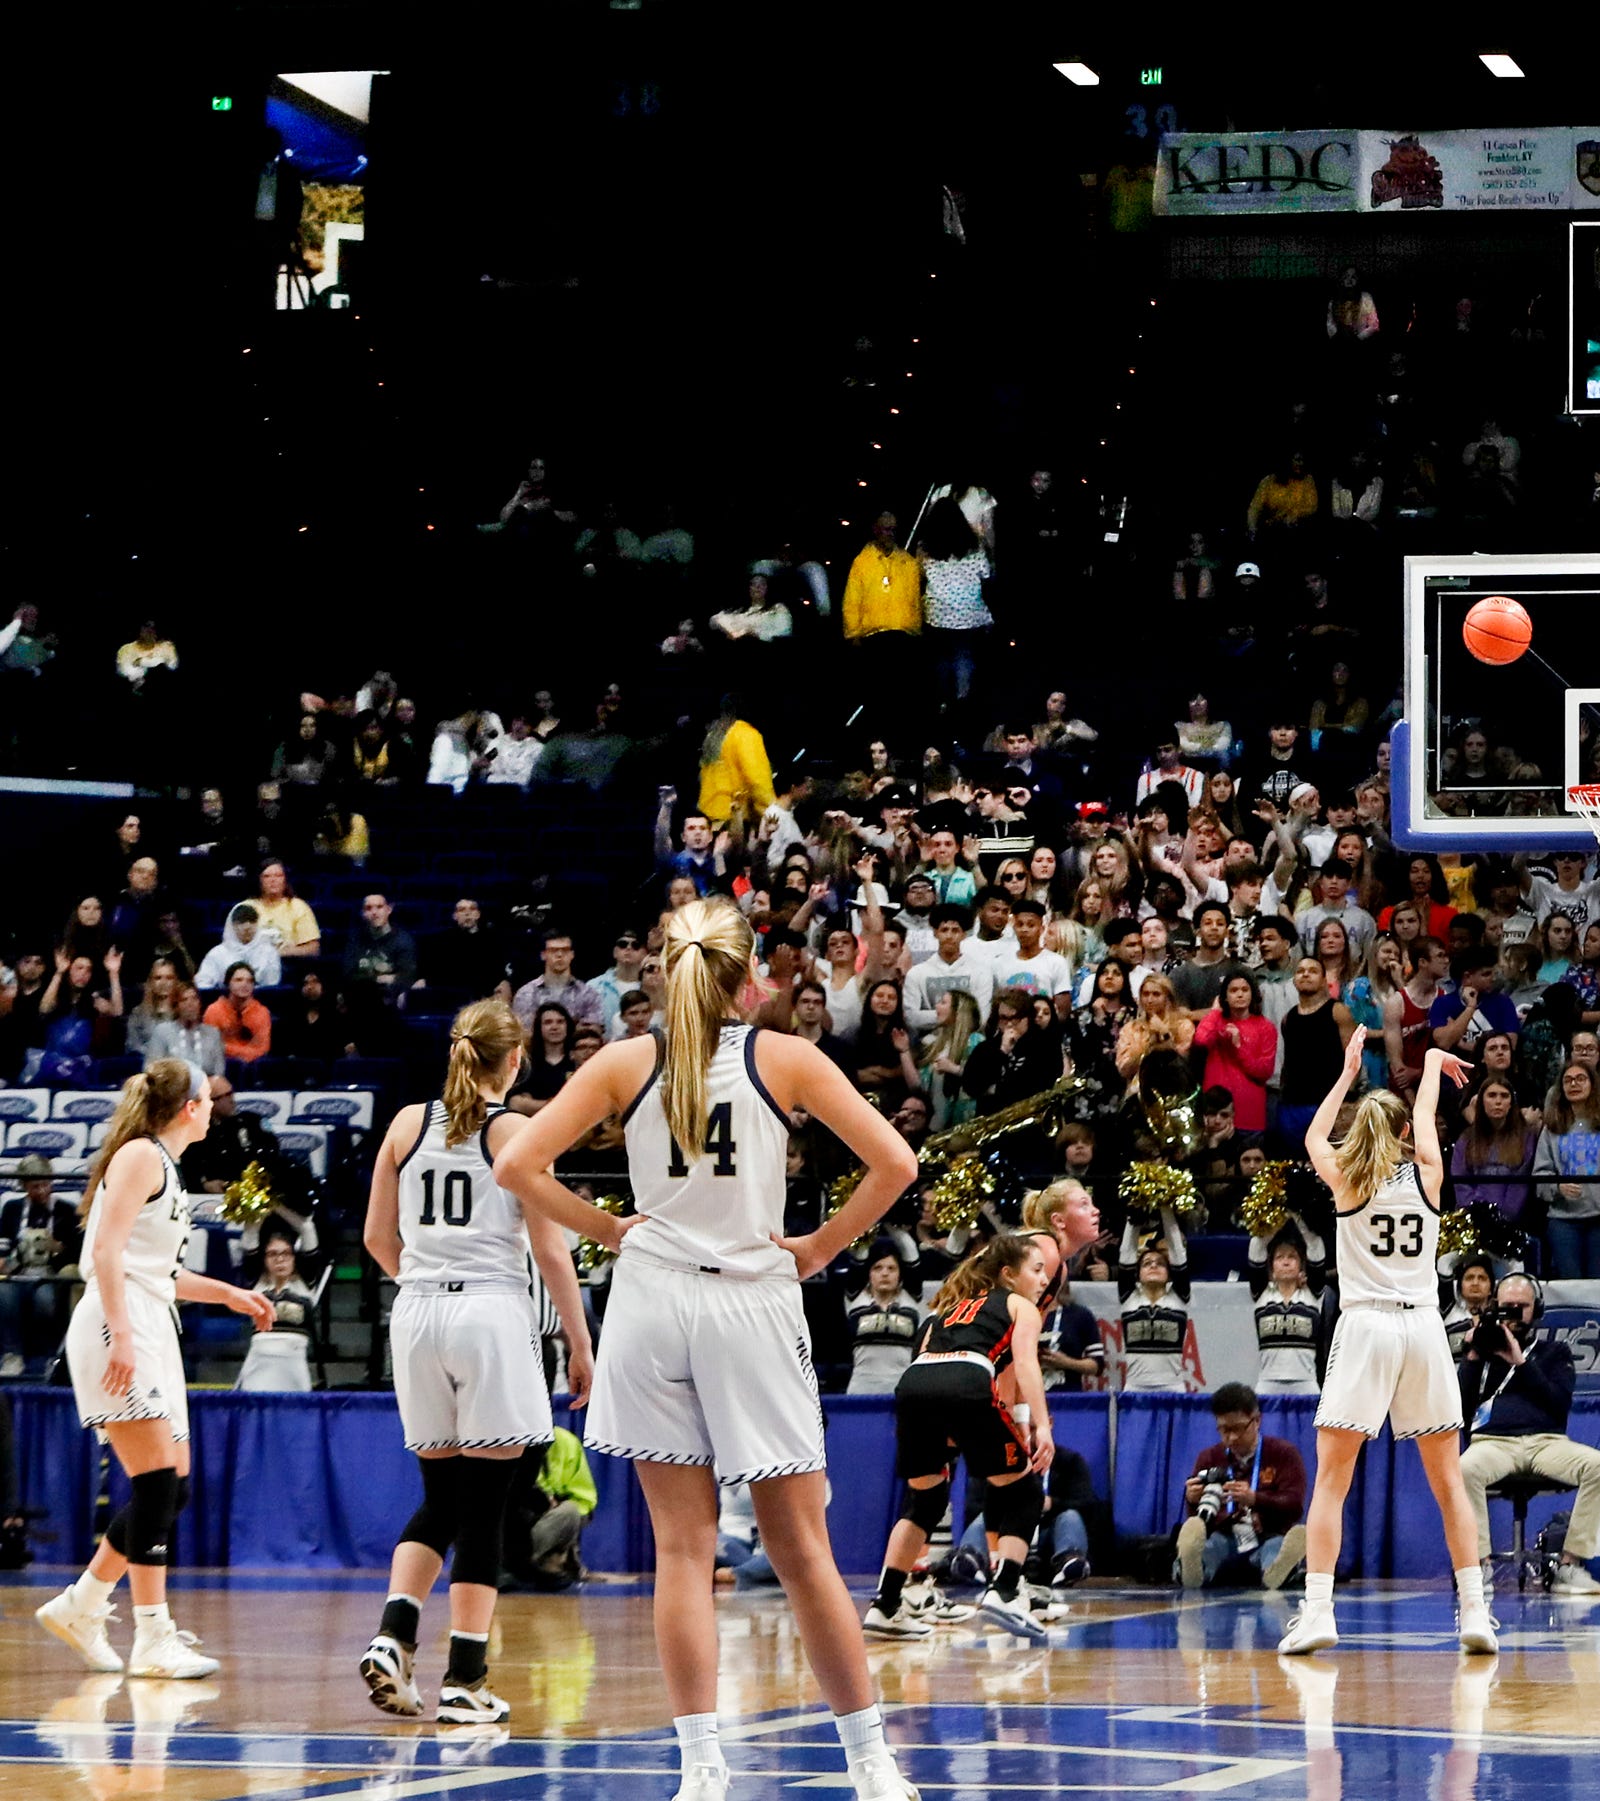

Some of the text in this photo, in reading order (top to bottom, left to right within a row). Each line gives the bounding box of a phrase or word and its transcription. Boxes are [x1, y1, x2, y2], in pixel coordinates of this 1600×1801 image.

[1167, 141, 1354, 194] KEDC
[419, 1169, 472, 1226] 10
[1371, 1214, 1423, 1257] 33
